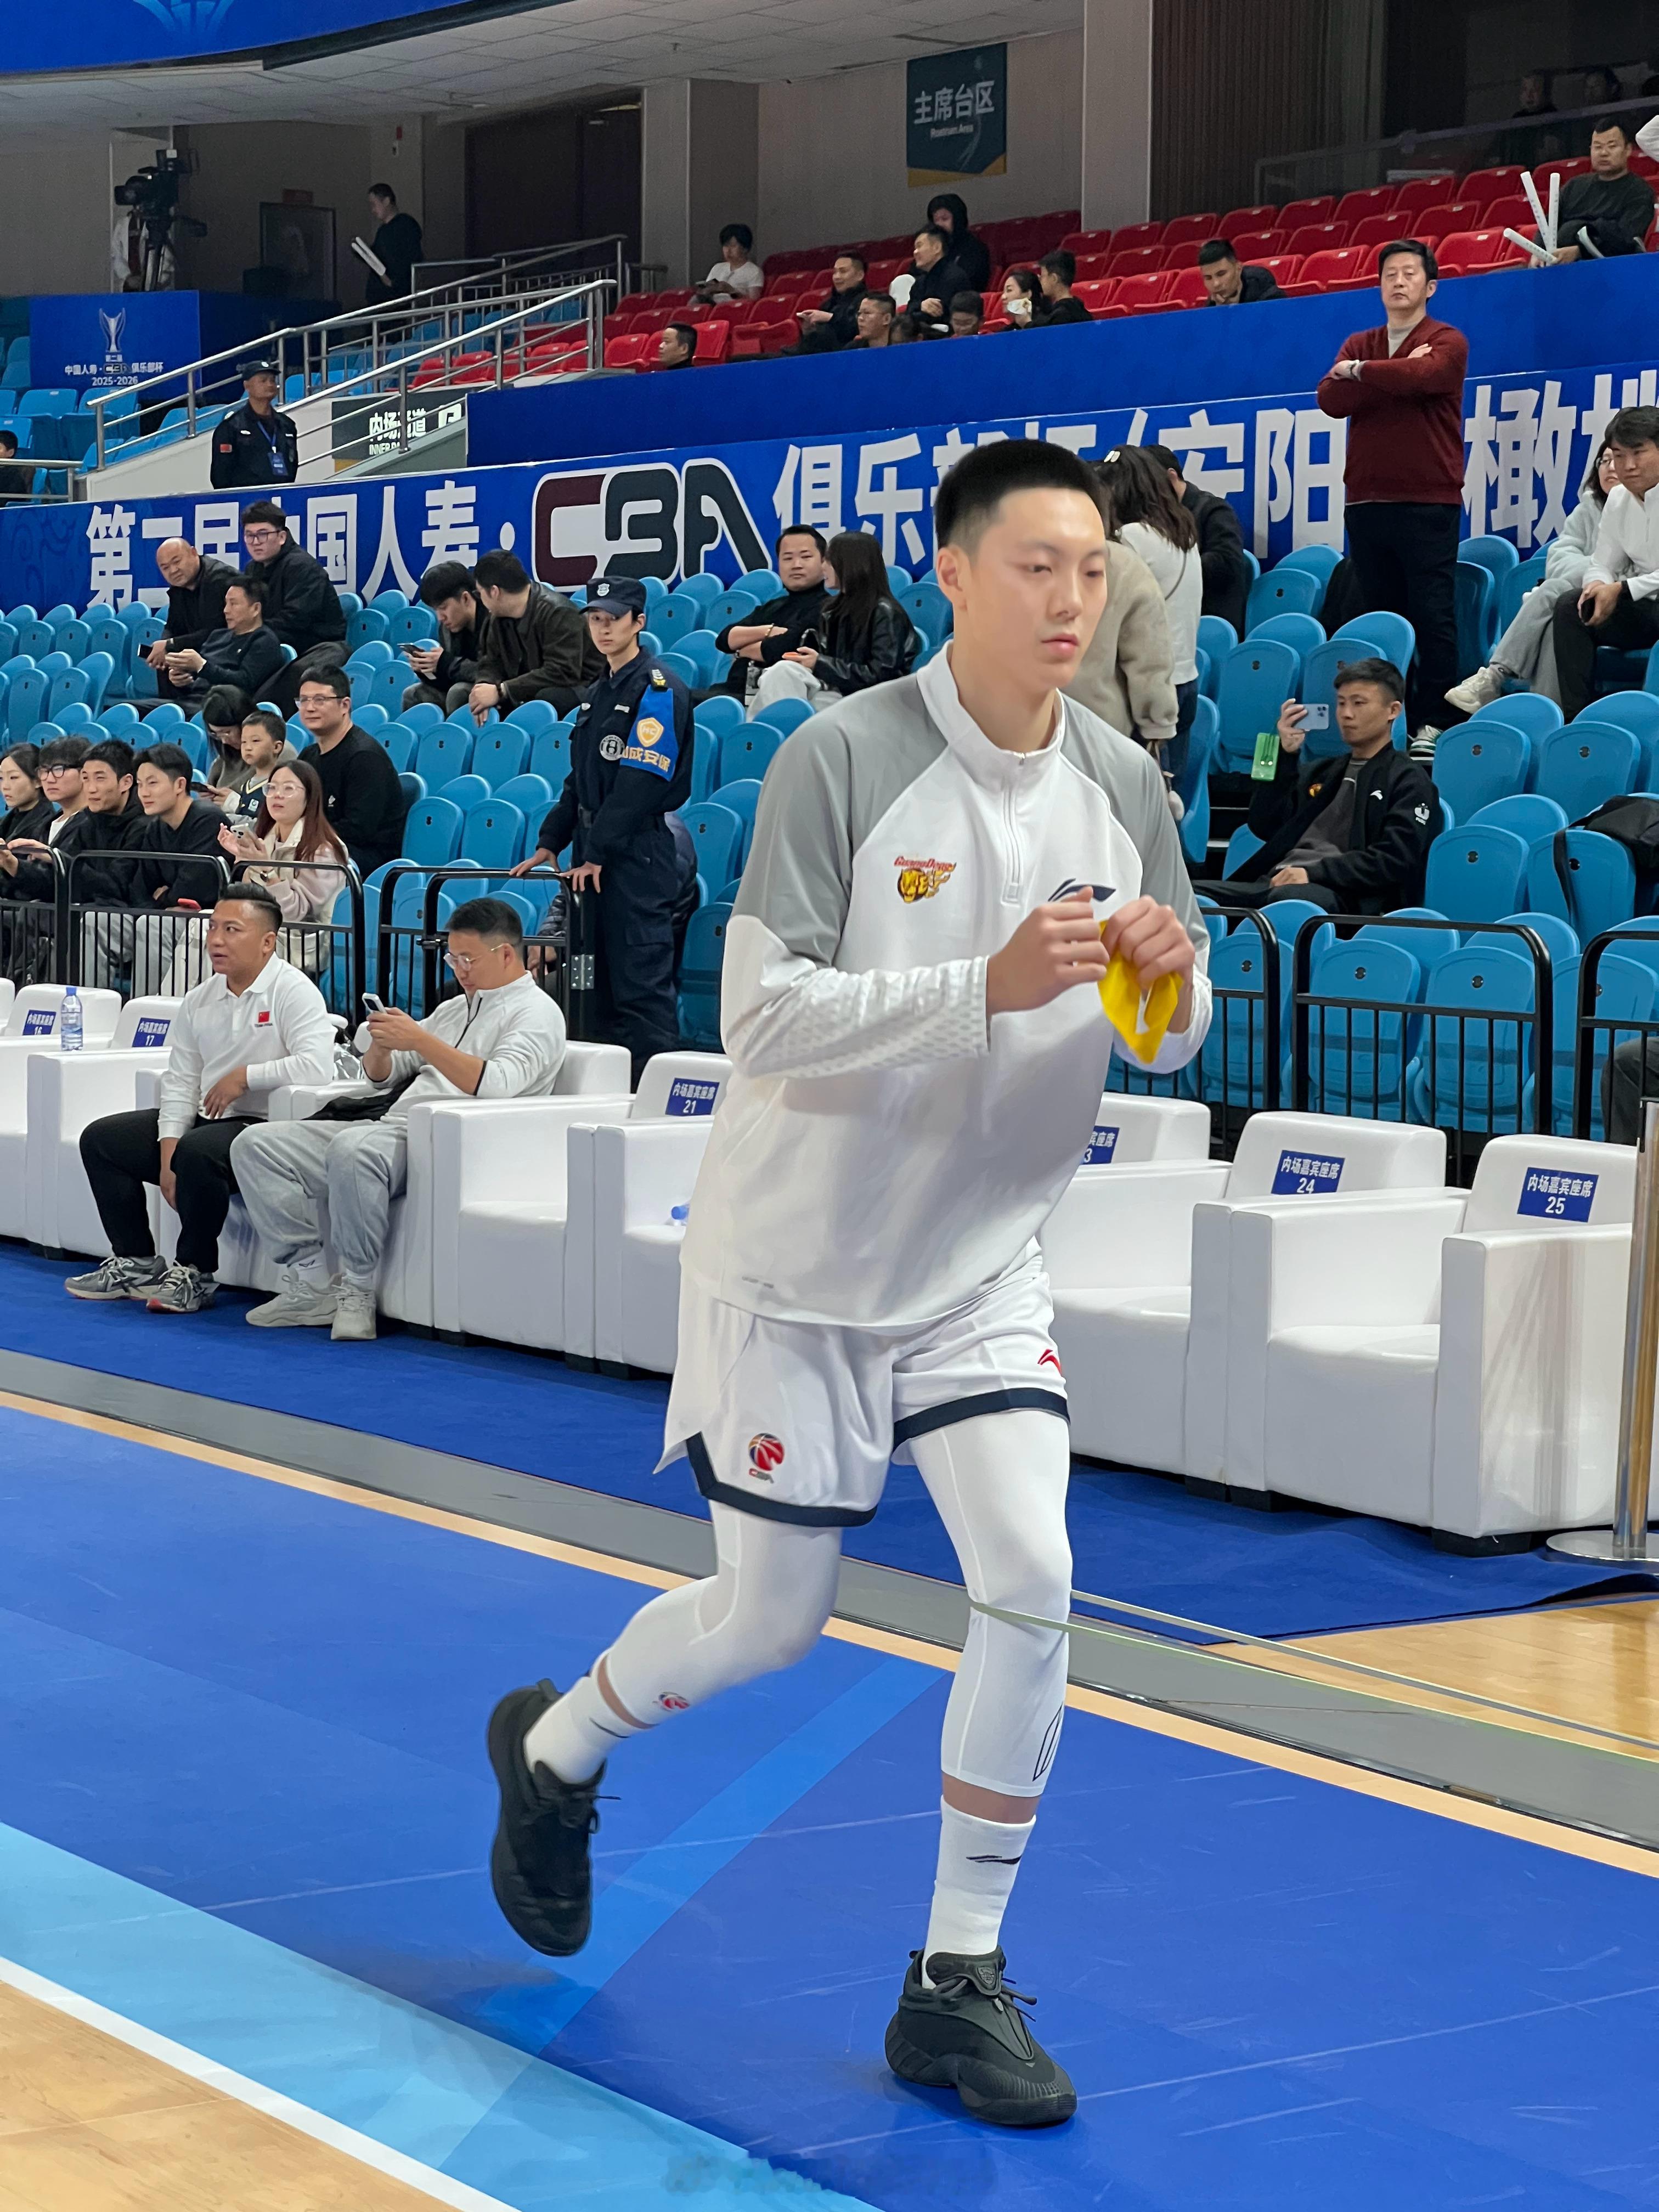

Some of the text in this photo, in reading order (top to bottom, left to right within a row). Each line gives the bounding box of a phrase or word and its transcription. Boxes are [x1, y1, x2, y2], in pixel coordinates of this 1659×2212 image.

[914, 81, 995, 125] 主席台区
[369, 408, 426, 442] 内场道
[532, 458, 772, 592] CBA
[145, 1035, 155, 1046] 17
[683, 1099, 696, 1114] 21
[1084, 1148, 1092, 1163] 3
[1280, 1155, 1340, 1180] 内场嘉宾座席
[1296, 1177, 1316, 1194] 24
[1527, 1173, 1594, 1198] 内场嘉宾座席
[1545, 1196, 1566, 1215] 25
